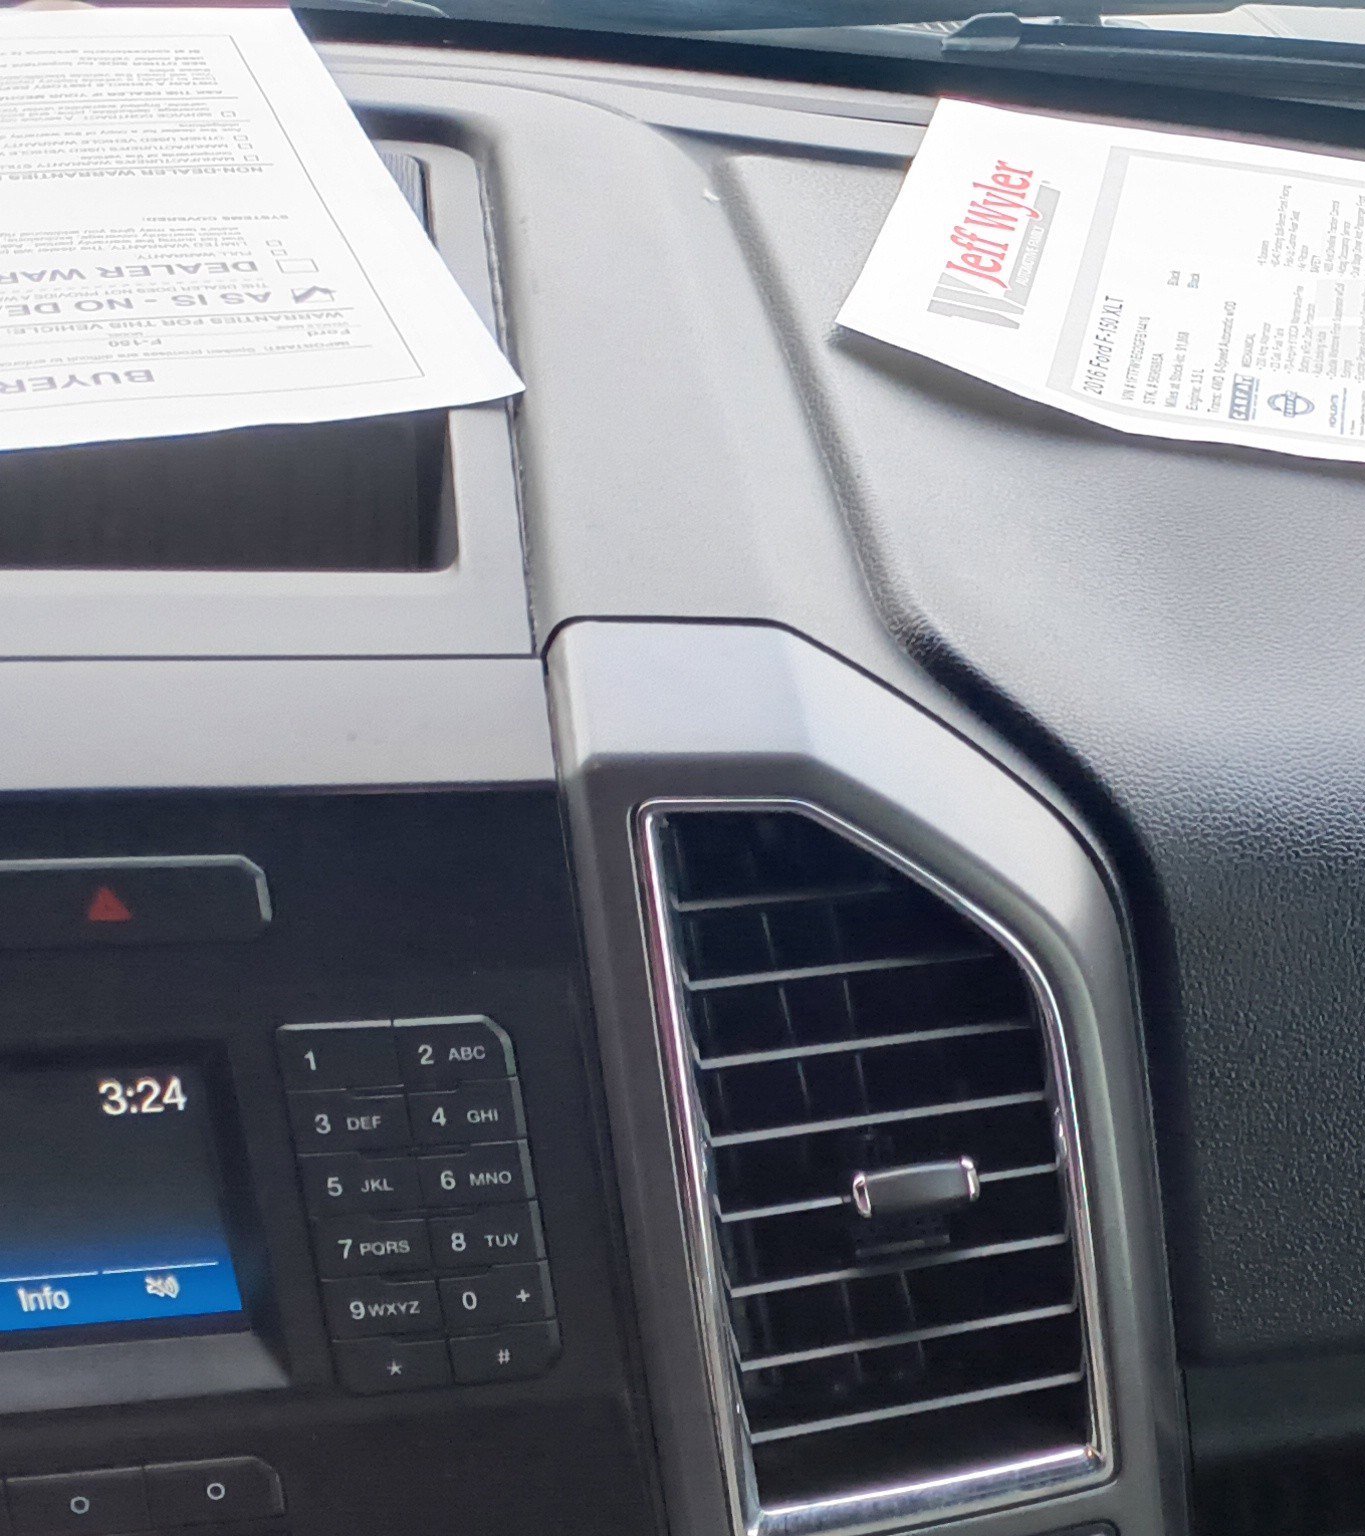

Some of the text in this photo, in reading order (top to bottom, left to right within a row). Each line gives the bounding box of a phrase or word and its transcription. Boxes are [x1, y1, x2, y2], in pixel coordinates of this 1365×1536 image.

[945, 160, 1040, 289] Jeff Wyler
[95, 260, 258, 279] DEALER
[0, 302, 61, 317] DE
[74, 298, 134, 312] NO
[171, 294, 208, 307] IS
[219, 291, 271, 306] AS
[161, 319, 205, 327] FOR
[210, 312, 343, 325] WARRANTIES
[1083, 294, 1125, 395] 2016 Ford F-150 XLT
[304, 1050, 317, 1071] 1
[418, 1044, 486, 1066] 2 ABC
[99, 1075, 187, 1116] 3:24
[314, 1112, 382, 1135] 3 DEF
[432, 1105, 499, 1127] 4 GHI
[326, 1175, 394, 1198] 5 JKL
[440, 1169, 512, 1192] 6 MNO
[337, 1238, 352, 1260] 7
[451, 1231, 519, 1253] 8 TUV
[18, 1285, 71, 1313] Info
[462, 1290, 477, 1312] 0
[349, 1300, 421, 1321] 9 WXYZ
